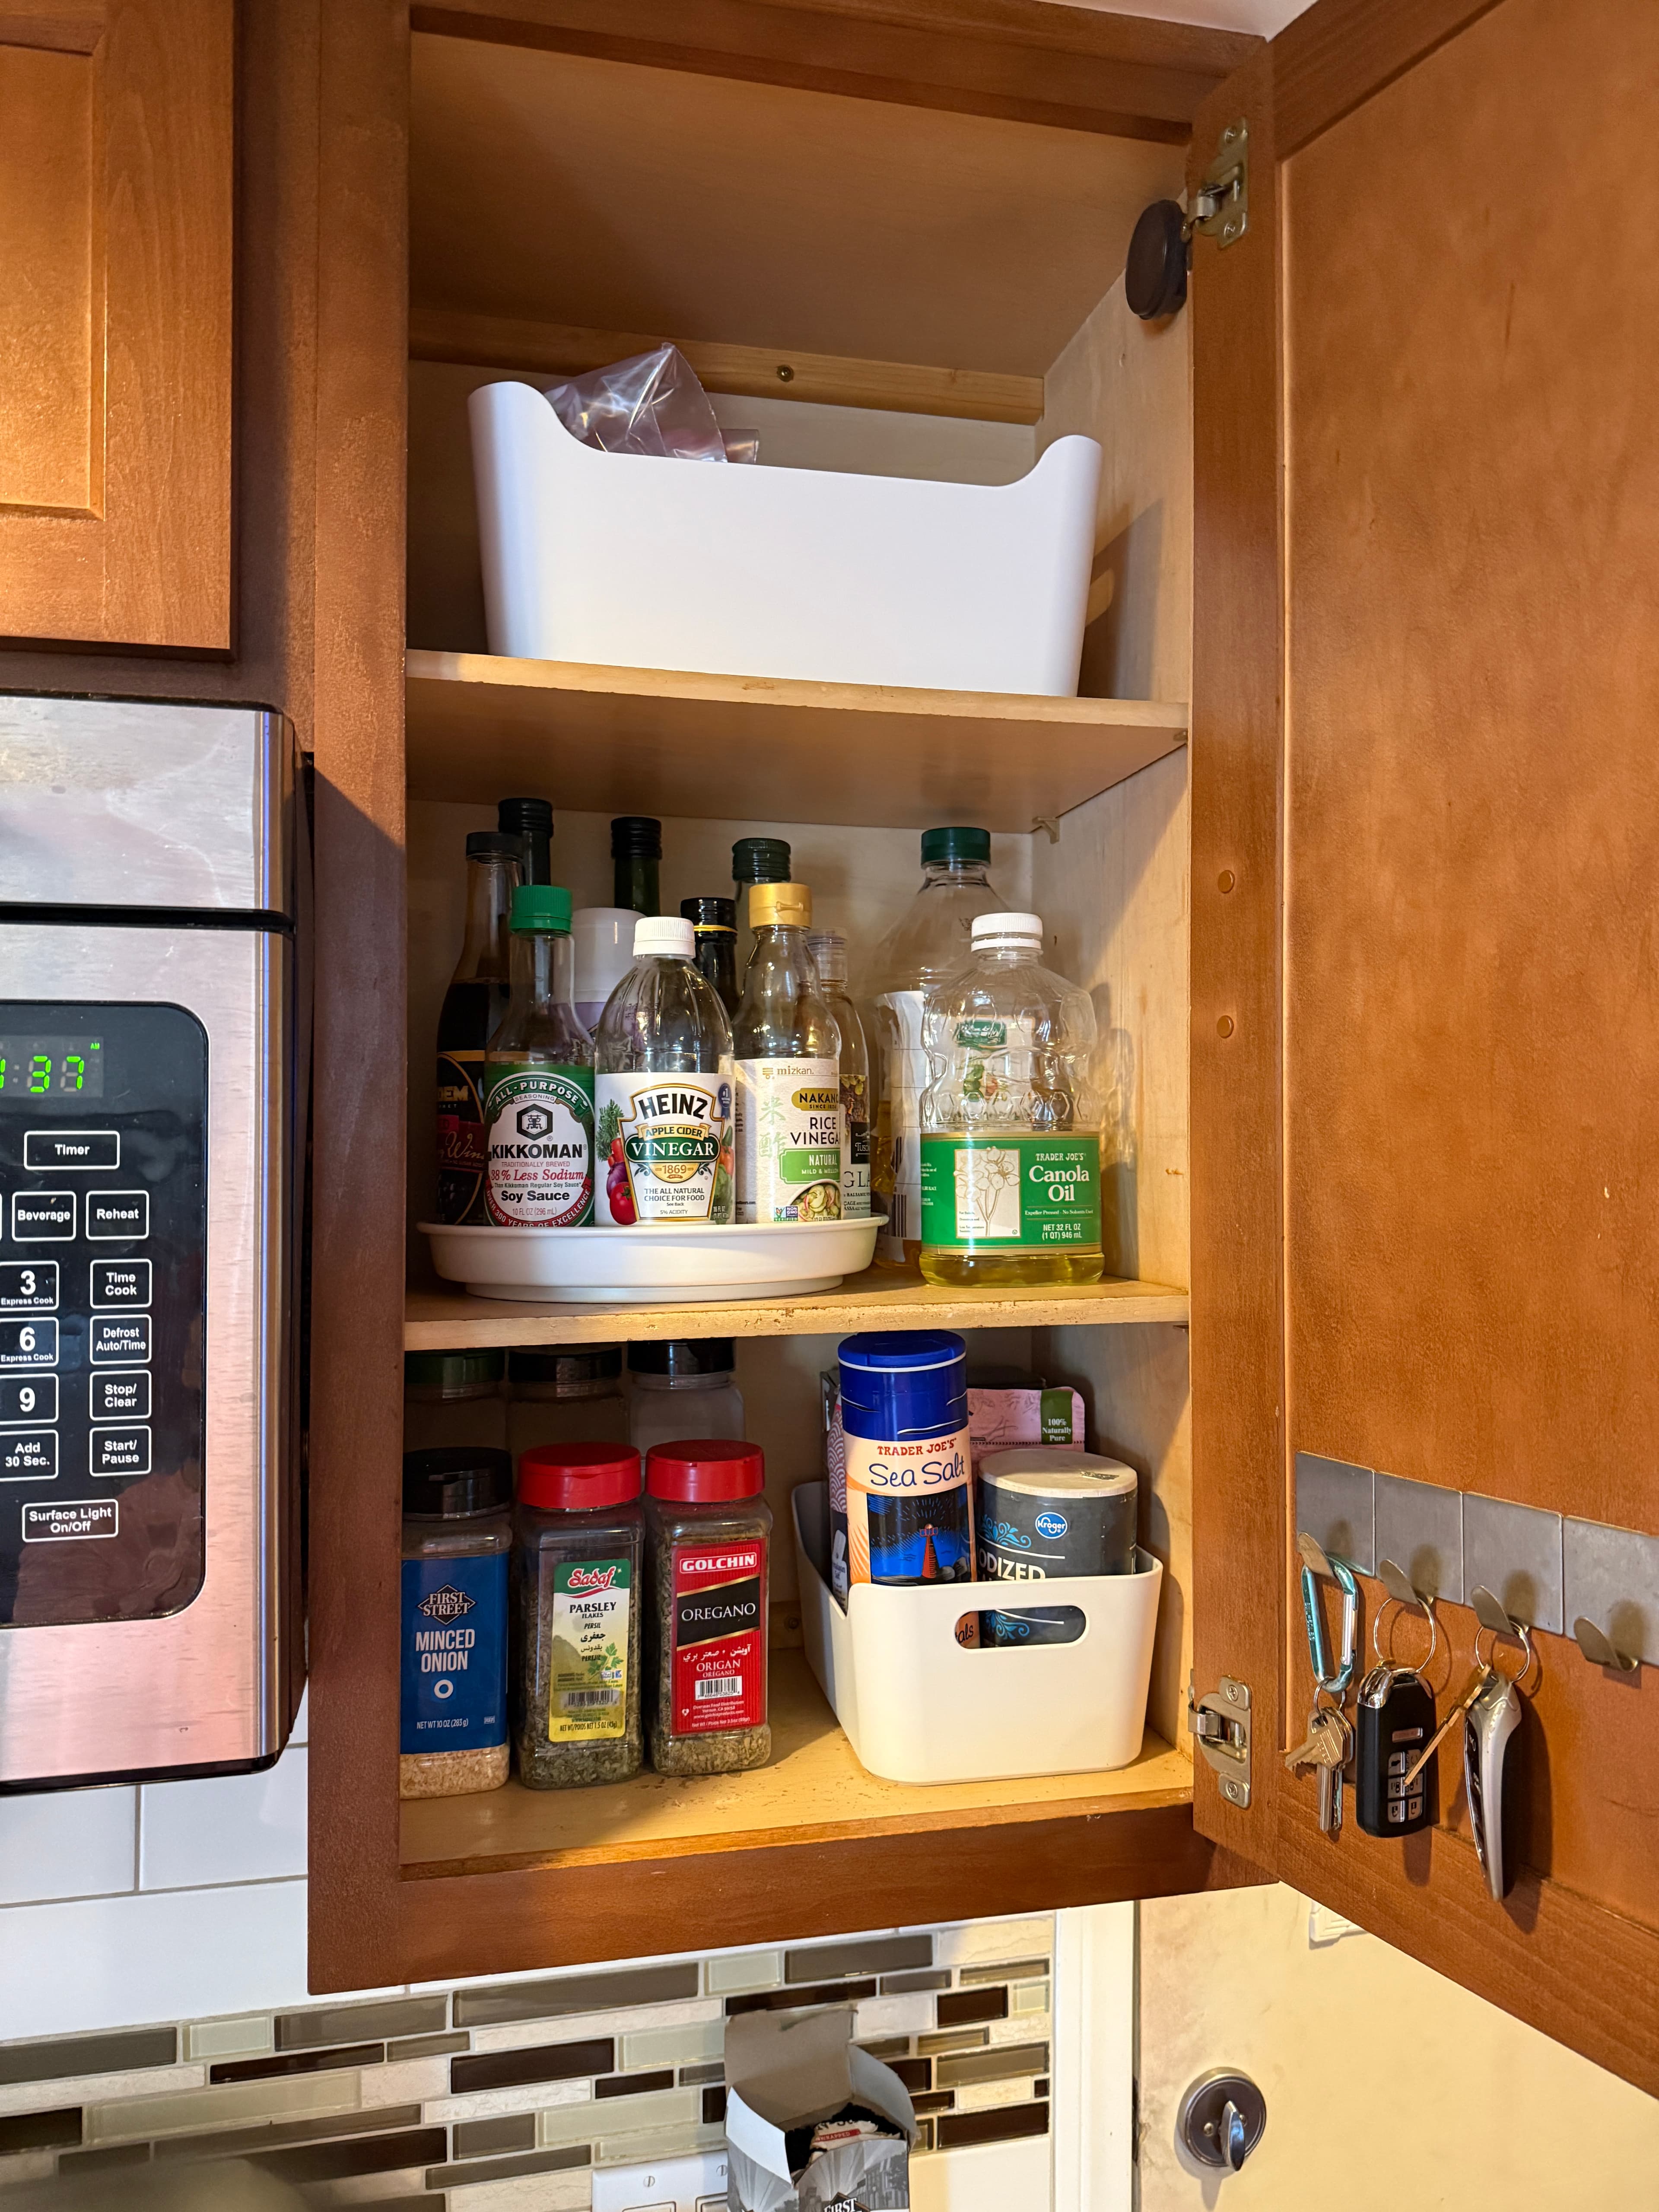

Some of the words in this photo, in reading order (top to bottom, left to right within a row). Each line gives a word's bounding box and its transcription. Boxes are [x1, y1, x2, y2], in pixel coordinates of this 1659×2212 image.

[495, 1081, 579, 1104] ALL-PURPOSE
[638, 1093, 709, 1120] HEINZ
[810, 1117, 836, 1130] RICE
[645, 1126, 674, 1137] APPLE
[676, 1126, 703, 1138] CIDER
[790, 1131, 840, 1145] VINEGA
[55, 1144, 90, 1156] Timer
[492, 1144, 582, 1159] KIKKOMAN
[631, 1142, 715, 1157] VINEGAR
[809, 1154, 837, 1166] NATURAL
[1036, 1153, 1064, 1161] TRADER
[1065, 1153, 1084, 1161] JOE'S
[513, 1169, 538, 1181] Less
[542, 1169, 584, 1180] Sodium
[662, 1164, 687, 1174] 1869
[1029, 1165, 1090, 1182] Canola
[501, 1190, 523, 1203] Soy
[527, 1190, 570, 1201] Sauce
[1048, 1184, 1075, 1202] Oil
[96, 1208, 139, 1220] Reheat
[486, 1189, 496, 1211] OVER
[495, 1210, 506, 1222] 300
[552, 1189, 591, 1227] EXCELLENCE
[18, 1209, 70, 1223] Beverage
[1042, 1232, 1048, 1240] (1
[1050, 1232, 1061, 1240] QT)
[20, 1270, 36, 1295] 3
[106, 1272, 136, 1283] Time
[105, 1284, 137, 1296] Cook
[0, 1298, 32, 1306] Express
[33, 1297, 54, 1305] Cook
[19, 1327, 35, 1351] 6
[103, 1327, 140, 1339] Defrost
[96, 1339, 146, 1352] Auto/Time
[0, 1354, 32, 1363] Express
[33, 1353, 54, 1361] Cook
[105, 1383, 137, 1397] Stop/
[19, 1387, 35, 1412] 9
[105, 1396, 137, 1408] Clear
[1042, 1427, 1072, 1435] Naturally
[15, 1442, 41, 1454] Add
[104, 1440, 137, 1452] Start/
[877, 1445, 924, 1456] TRADER
[926, 1438, 954, 1454] JOE'S
[6, 1456, 20, 1467] 30
[23, 1455, 51, 1467] Sec.
[102, 1452, 140, 1465] Pause
[868, 1462, 918, 1487] Sea
[921, 1452, 965, 1485] Salt
[29, 1509, 77, 1522] Surface
[80, 1507, 112, 1521] Light
[50, 1520, 91, 1533] On/Off
[1037, 1516, 1065, 1534] Kroger
[682, 1554, 755, 1572] GOLCHIN
[979, 1548, 1046, 1580] ODIZED
[568, 1566, 616, 1588] Sadaf
[429, 1592, 466, 1606] FIRST
[423, 1602, 470, 1617] STREET
[569, 1602, 617, 1613] PARSLEY
[681, 1603, 756, 1622] OREGANO
[416, 1628, 475, 1651] MINCED
[421, 1650, 468, 1673] ONION
[696, 1659, 741, 1672] ORIGAN
[416, 1721, 427, 1729] NET
[427, 1720, 436, 1729] WT
[437, 1720, 442, 1728] 10
[443, 1719, 450, 1728] OZ
[451, 1719, 463, 1728] (283
[463, 1718, 468, 1727] g)
